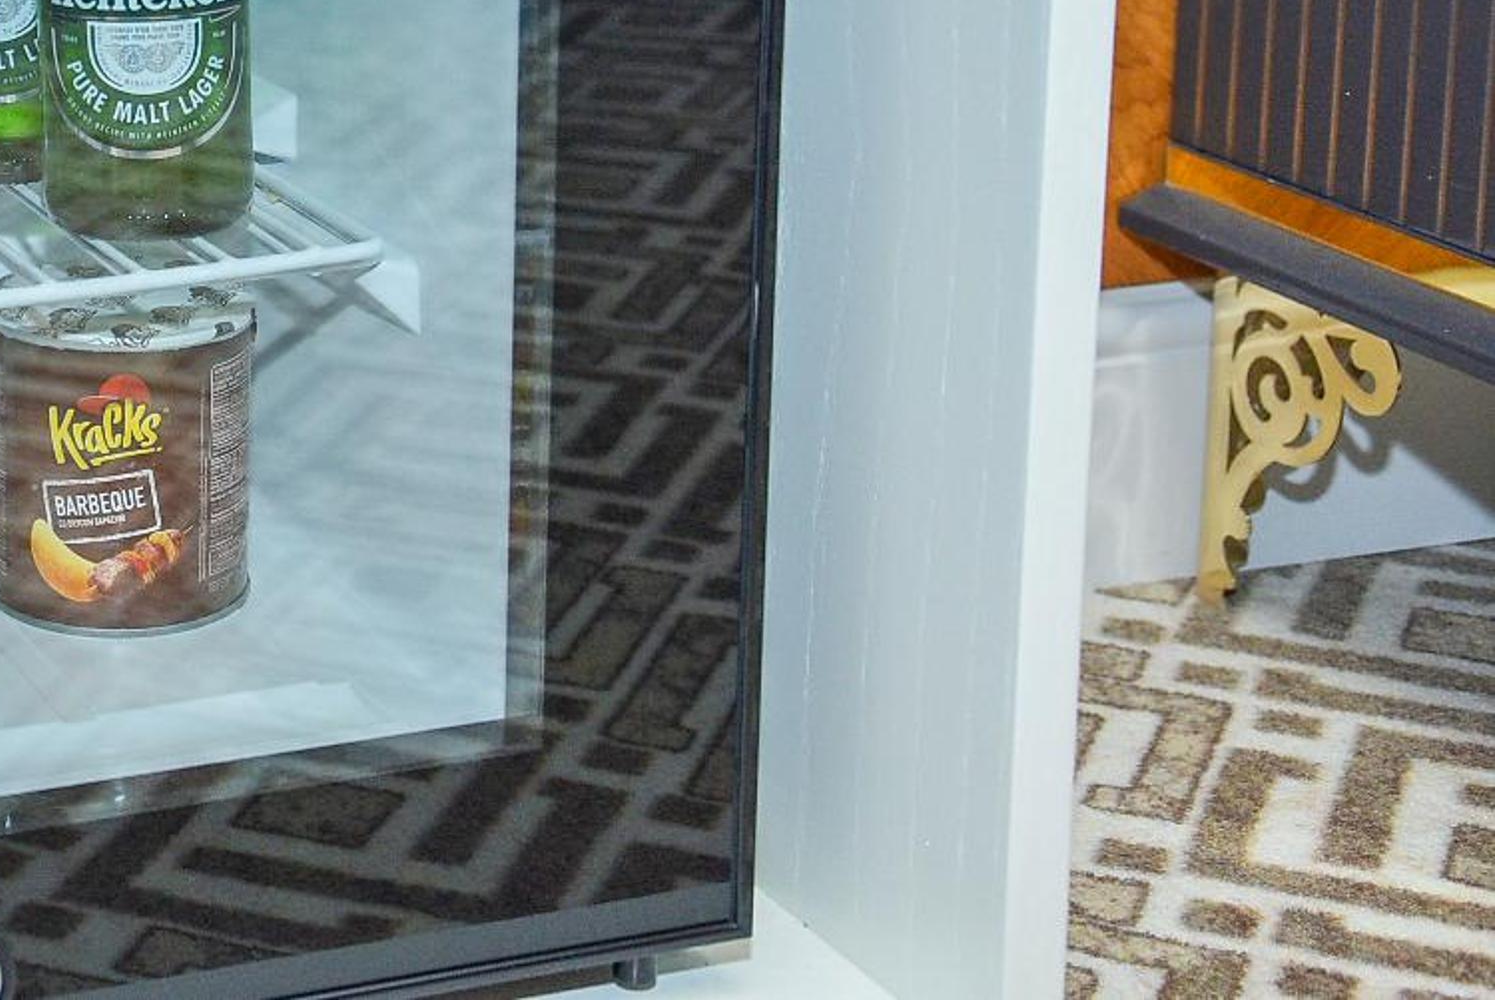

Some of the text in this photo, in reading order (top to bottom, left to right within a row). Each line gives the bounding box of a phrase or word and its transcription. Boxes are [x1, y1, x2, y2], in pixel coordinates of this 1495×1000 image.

[67, 60, 109, 113] PURE
[113, 100, 170, 125] MALT
[178, 55, 224, 115] LAGER
[54, 486, 147, 517] BARBEQUE
